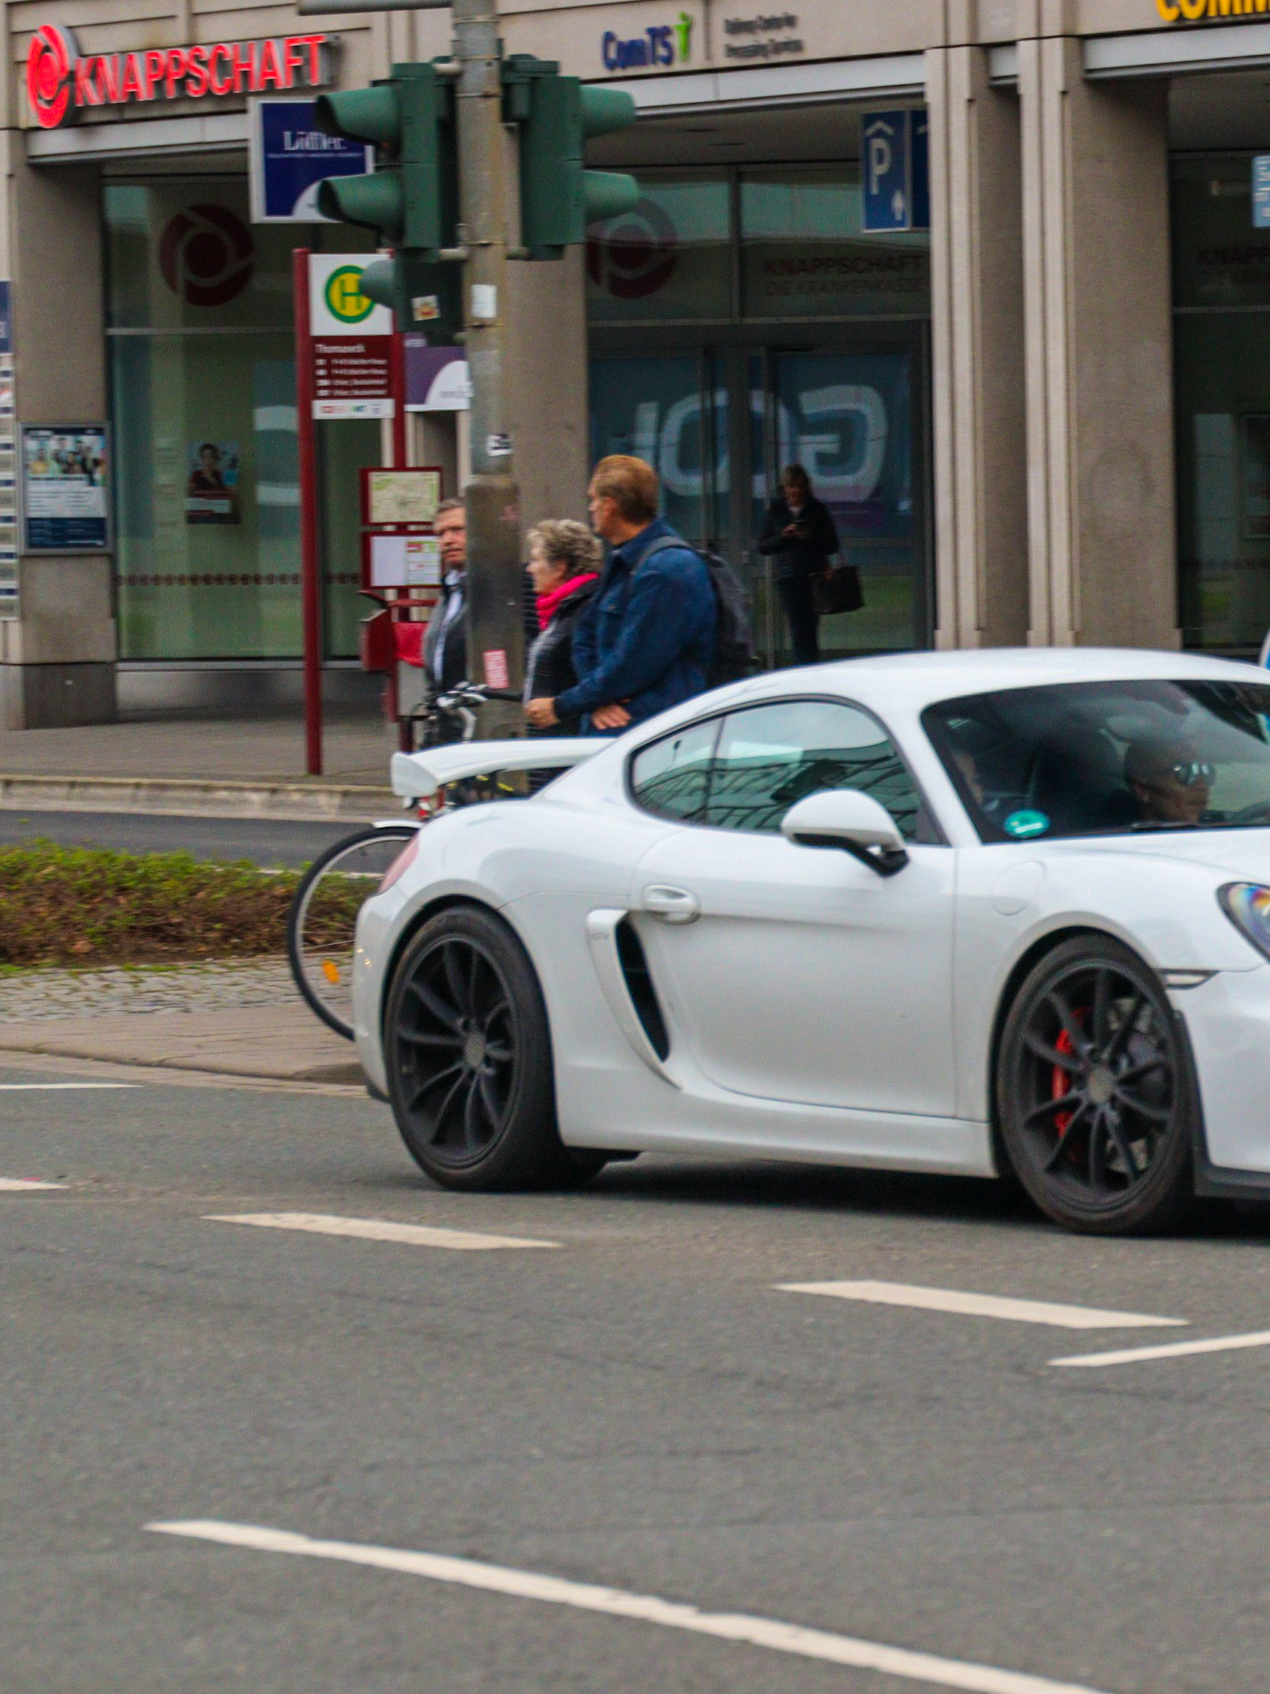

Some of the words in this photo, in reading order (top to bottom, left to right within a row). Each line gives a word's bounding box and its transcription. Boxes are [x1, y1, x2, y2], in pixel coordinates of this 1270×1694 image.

[75, 34, 327, 107] KNAPPSCHAFT
[870, 138, 892, 196] P
[339, 278, 363, 311] H
